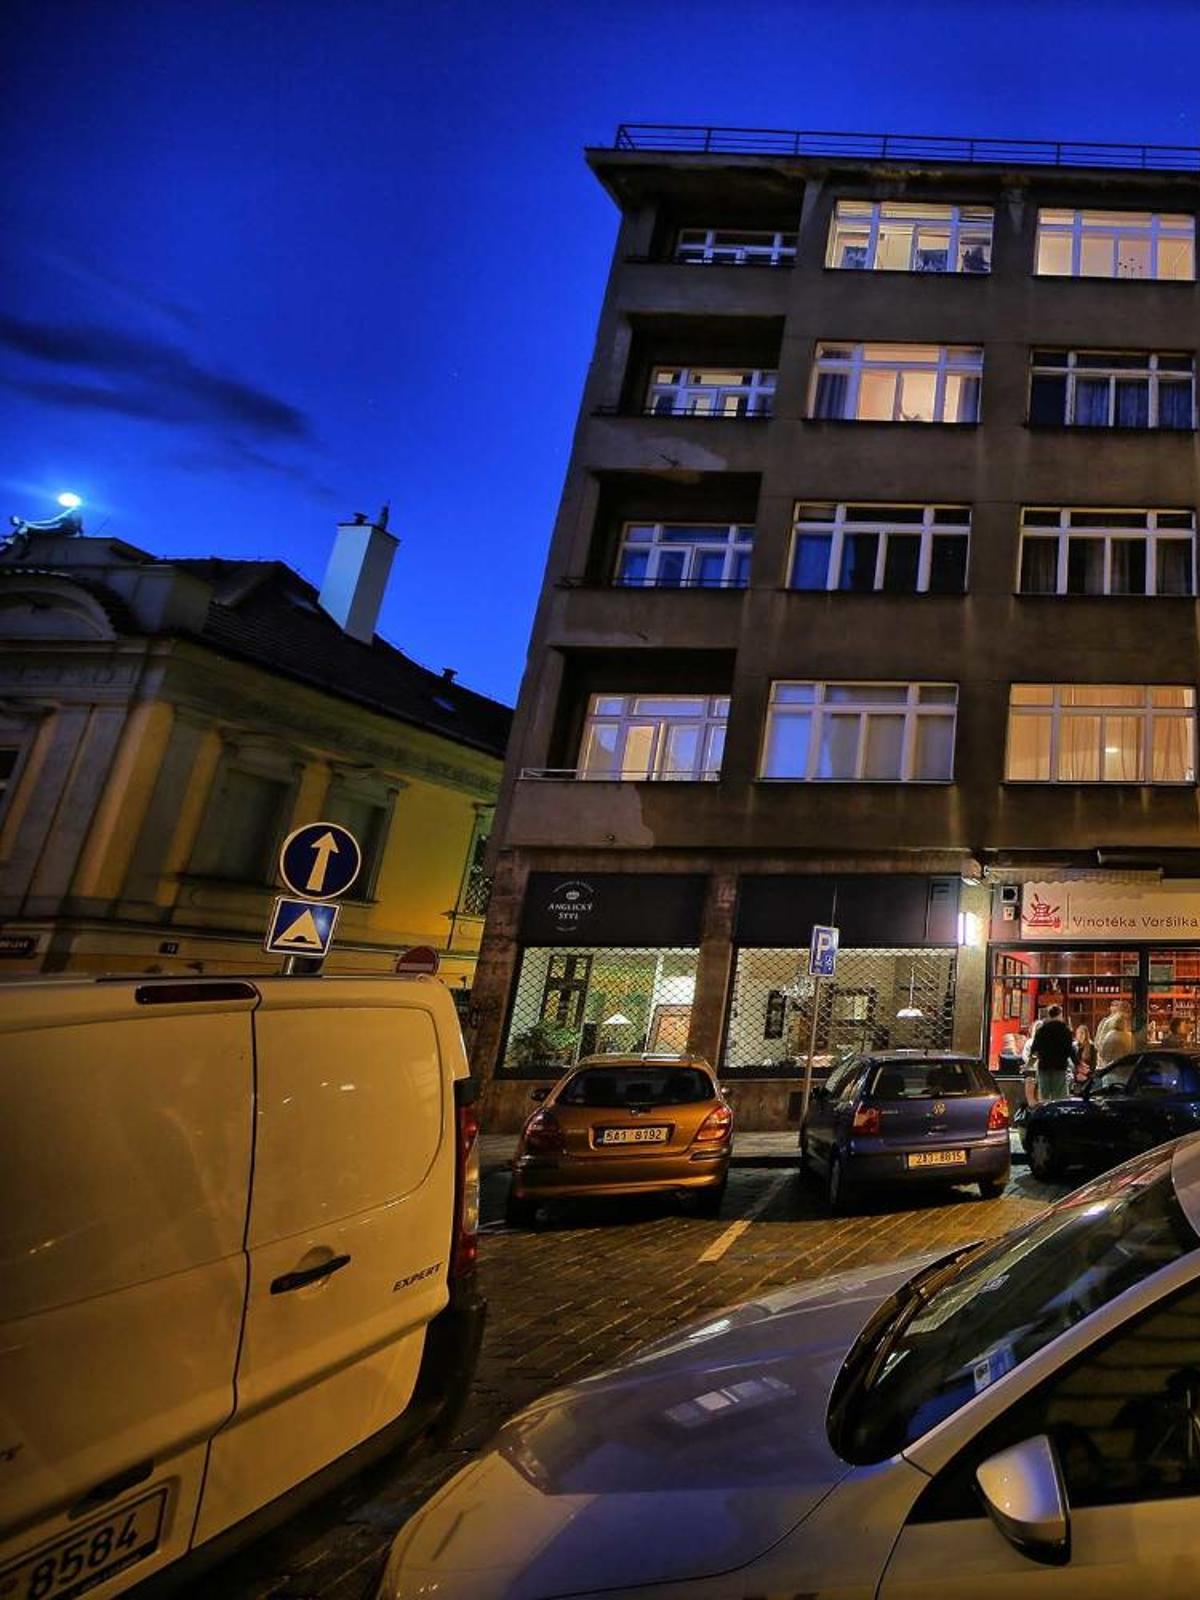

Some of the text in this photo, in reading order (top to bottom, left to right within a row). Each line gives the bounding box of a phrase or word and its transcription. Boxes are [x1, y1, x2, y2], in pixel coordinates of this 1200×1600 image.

[1072, 916, 1137, 928] Vinotéka
[817, 931, 831, 961] P
[392, 1261, 444, 1293] EXPERT
[27, 1510, 138, 1600] 8584
